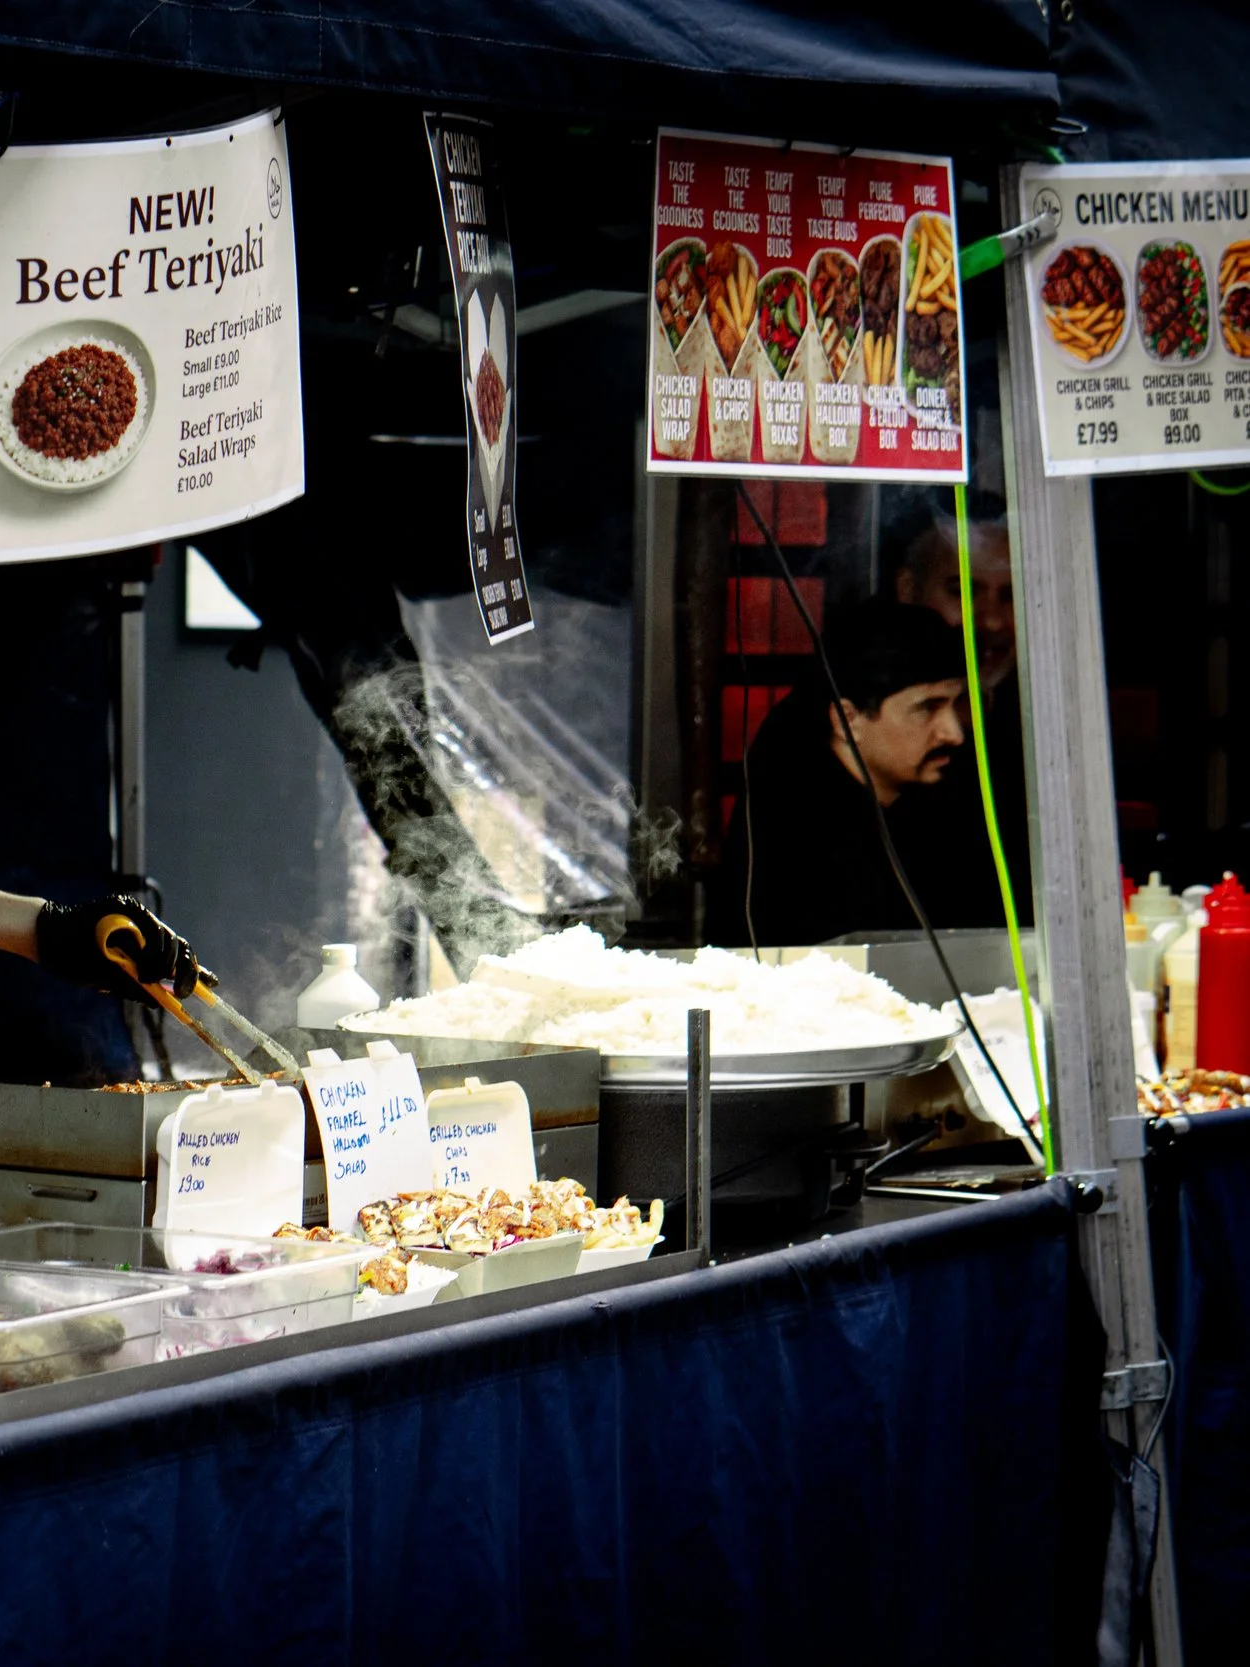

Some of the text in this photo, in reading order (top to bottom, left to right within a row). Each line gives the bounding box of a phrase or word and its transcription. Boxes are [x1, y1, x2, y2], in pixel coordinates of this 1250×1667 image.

[443, 131, 482, 176] CHICKEN
[668, 161, 695, 183] TASTE
[724, 166, 750, 189] TASTE
[765, 170, 794, 192] TEMPT
[672, 184, 689, 205] THE
[817, 175, 846, 197] TEMPT
[869, 180, 893, 202] PURE
[913, 185, 938, 207] PURE
[129, 186, 215, 235] NEW!
[450, 180, 487, 226] TERIYAKI
[728, 190, 745, 210] THE
[767, 193, 791, 214] YOUR
[821, 198, 844, 219] YOUR
[1075, 191, 1174, 225] CHICKEN
[1181, 188, 1249, 222] MENU
[657, 205, 704, 229] GOODNESS
[859, 202, 905, 223] PERFECTION
[766, 215, 792, 236] TASTE
[807, 218, 858, 242] TASTE BUDS
[456, 230, 477, 273] RICE
[767, 238, 792, 259] BUDS
[15, 222, 265, 305] Beef Teriyaki
[184, 303, 282, 349] Beef Teriyaki Rice
[183, 349, 240, 376] Small £9.00
[182, 370, 240, 399] Large £11.00
[656, 375, 697, 396] CHICKEN
[712, 377, 751, 399] CHICKEN
[763, 380, 804, 402] CHICKEN
[1056, 377, 1131, 394] CHICKEN GRILL
[1142, 372, 1213, 389] CHICKEN GRILL
[1075, 395, 1115, 411] & CHIPS
[1146, 390, 1210, 407] & RICE SALAD
[1224, 387, 1245, 402] PITA
[661, 397, 690, 419] SALAD
[715, 400, 749, 421] & CHIPS
[766, 403, 801, 423] & MEAT
[815, 405, 861, 426] HALLOUMI
[1170, 408, 1189, 422] BOX
[1233, 404, 1240, 419] &
[180, 398, 263, 441] Beef Teriyaki
[662, 420, 690, 441] WRAP
[829, 427, 847, 447] BOX
[879, 429, 898, 449] BOX
[911, 430, 958, 451] SALAD BOX
[1077, 421, 1118, 445] £7.99
[177, 434, 256, 469] Salad Wraps
[177, 471, 213, 493] £10.00
[320, 1080, 366, 1107] CHICKEN
[327, 1110, 367, 1132] FALAFEL
[210, 1130, 240, 1146] CHICKEN
[430, 1122, 497, 1142] GRILLED CHICKEN
[192, 1153, 211, 1167] RICE
[334, 1159, 366, 1180] SALAD
